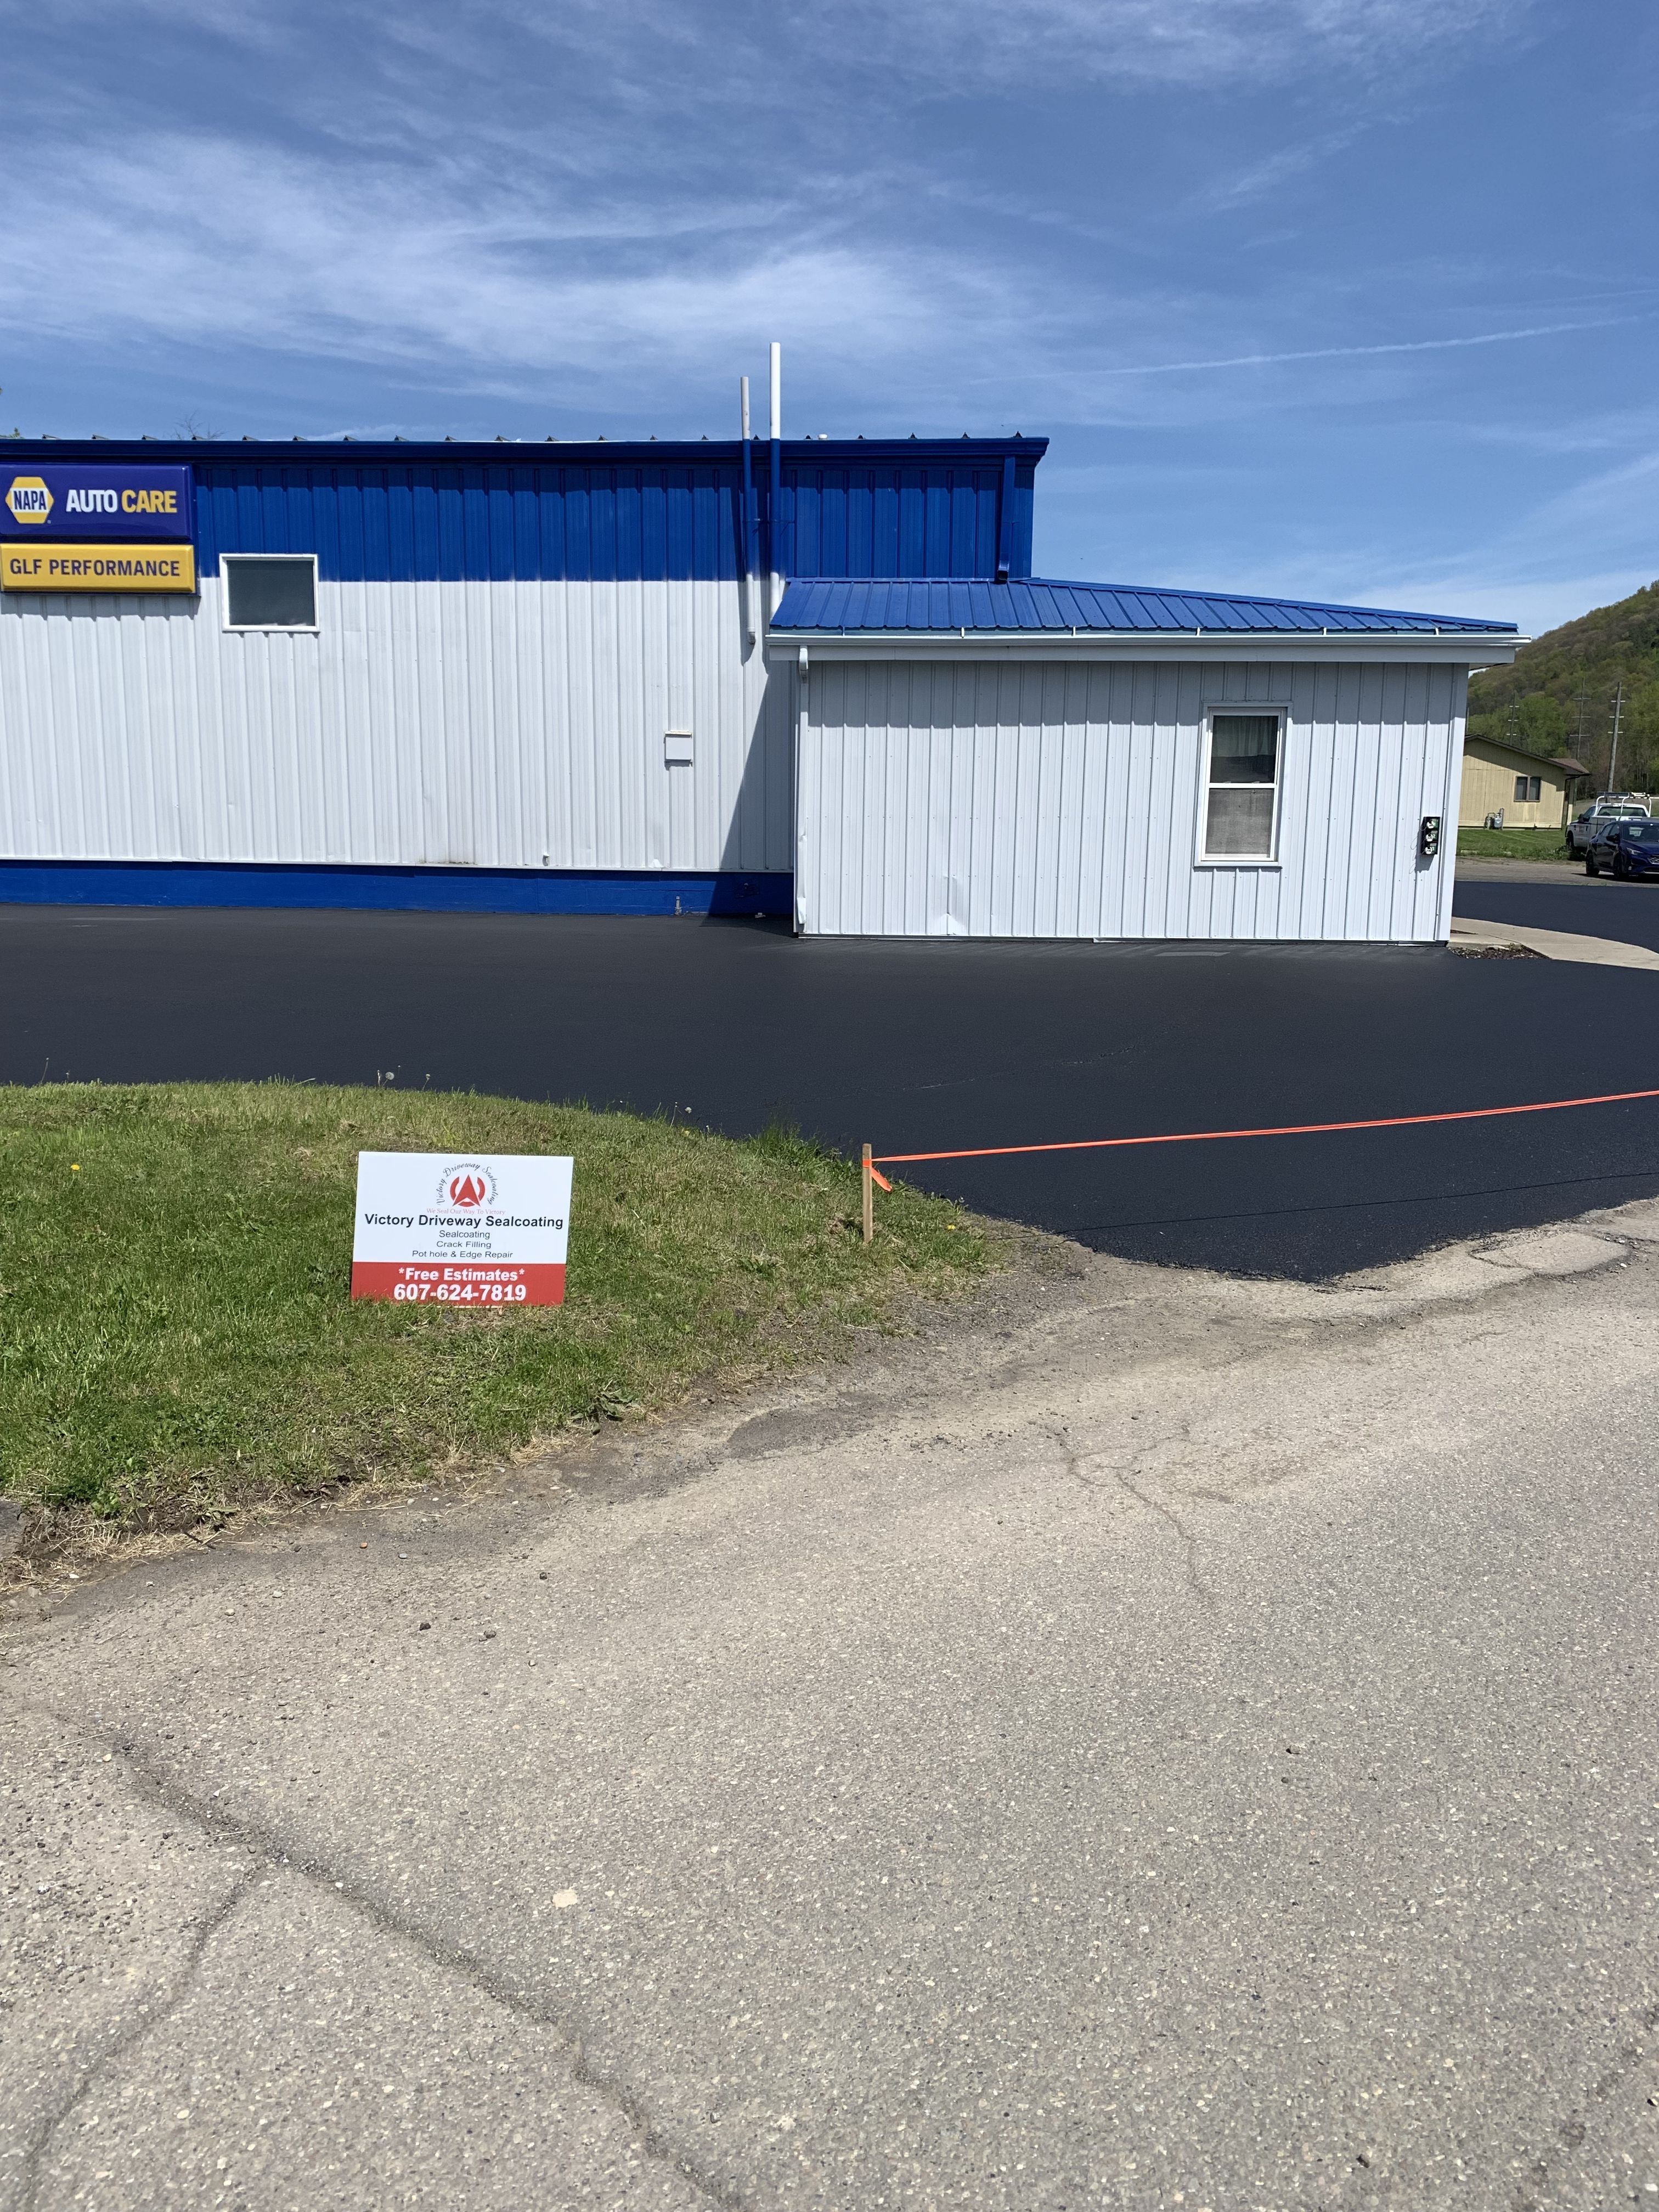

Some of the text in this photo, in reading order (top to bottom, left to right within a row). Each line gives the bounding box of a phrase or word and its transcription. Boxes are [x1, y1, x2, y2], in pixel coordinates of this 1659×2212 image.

[13, 490, 47, 511] NAPA
[66, 489, 178, 513] AUTO CARE
[10, 558, 180, 577] GLF PERFORMANCE
[436, 1163, 499, 1205] Victory Driveway Sealcoating
[364, 1214, 564, 1230] Victory Driveway Sealcoating
[439, 1230, 490, 1240] Sealcoating
[466, 1241, 492, 1249] Filling
[460, 1251, 482, 1259] Edge
[393, 1284, 527, 1301] 607-624-7819
